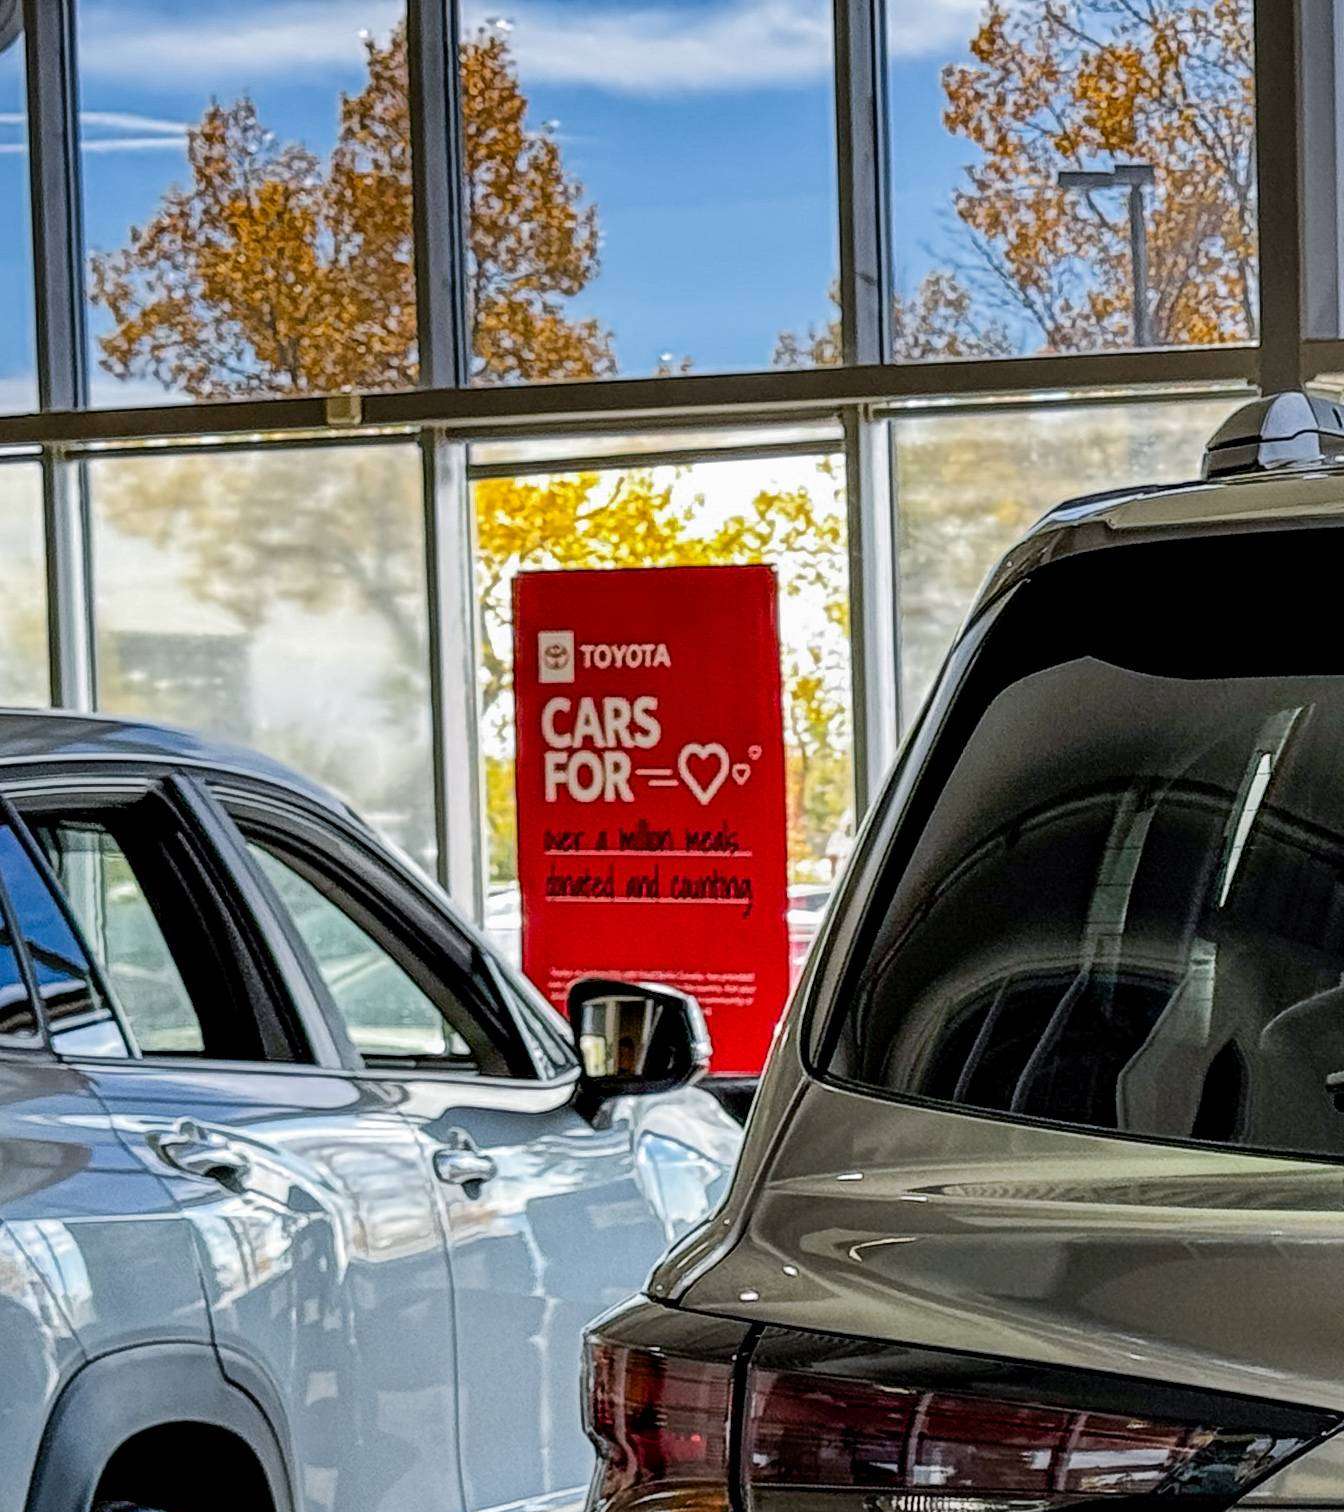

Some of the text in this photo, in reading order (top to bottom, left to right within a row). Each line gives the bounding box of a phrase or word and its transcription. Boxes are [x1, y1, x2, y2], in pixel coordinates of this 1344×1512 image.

[579, 643, 671, 668] TOYOTA
[541, 696, 661, 748] CARS
[544, 751, 635, 802] FOR
[596, 829, 609, 851] a
[625, 864, 659, 898] and
